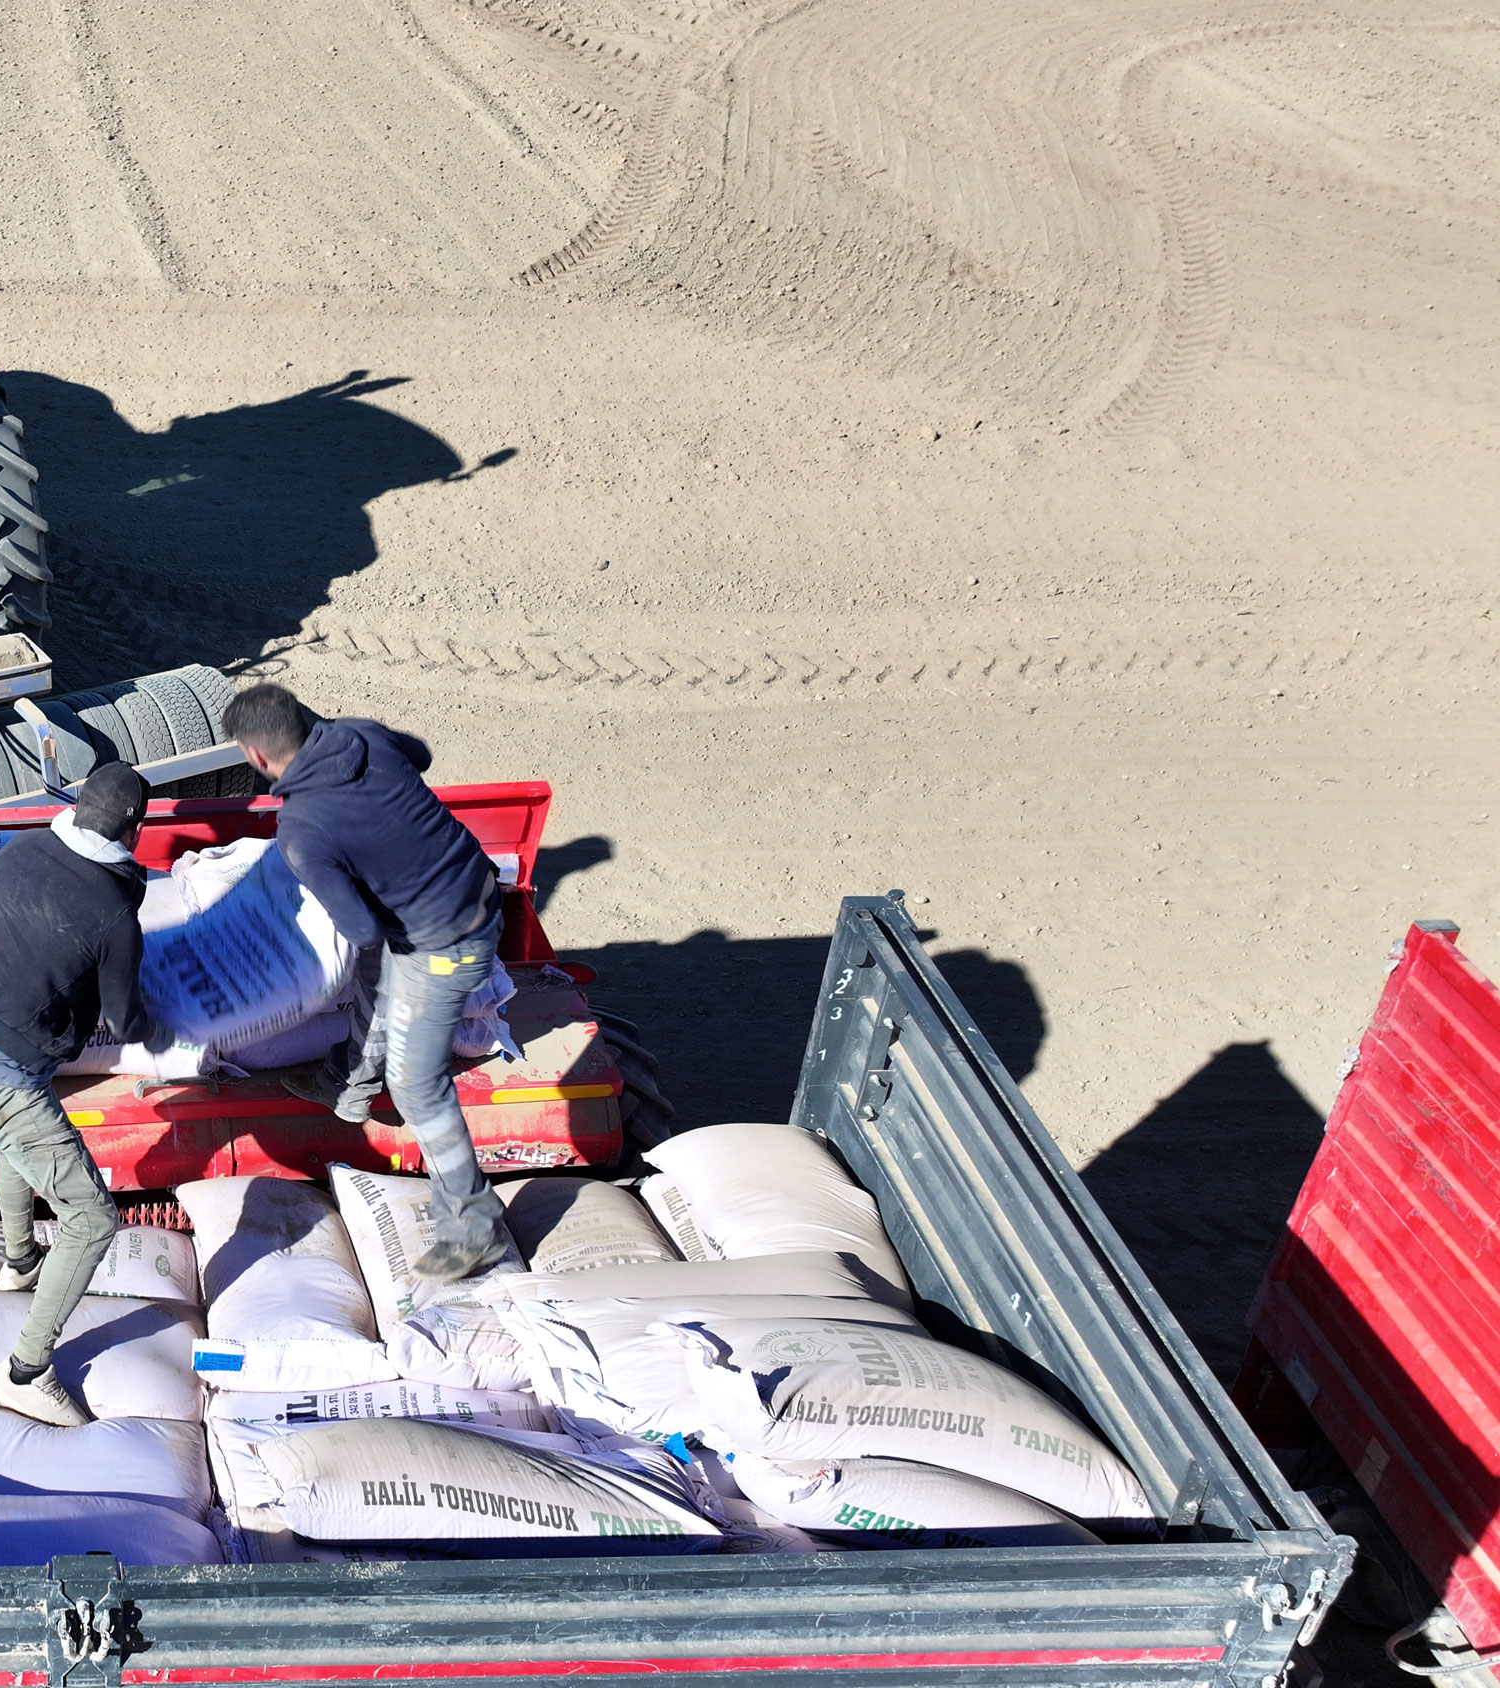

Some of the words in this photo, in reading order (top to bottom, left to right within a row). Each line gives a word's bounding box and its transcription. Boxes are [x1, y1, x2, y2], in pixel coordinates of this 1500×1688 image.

[834, 978, 848, 994] 2
[842, 968, 853, 982] 3
[830, 1006, 842, 1020] 3
[818, 1048, 827, 1061] 1
[661, 1186, 692, 1222] HALİL
[350, 1173, 386, 1206] HALİL
[372, 1202, 410, 1282] TOHUMCULUK
[676, 1218, 708, 1262] TOHUMC
[129, 1232, 143, 1260] TANER
[455, 1401, 476, 1423] NER
[846, 1405, 986, 1437] TOHUMCULUK
[1010, 1424, 1092, 1472] TANER
[361, 1473, 426, 1506] HALİL
[430, 1483, 580, 1532] TOHUMCULUK
[590, 1511, 685, 1542] TANER
[833, 1503, 927, 1547] TANER
